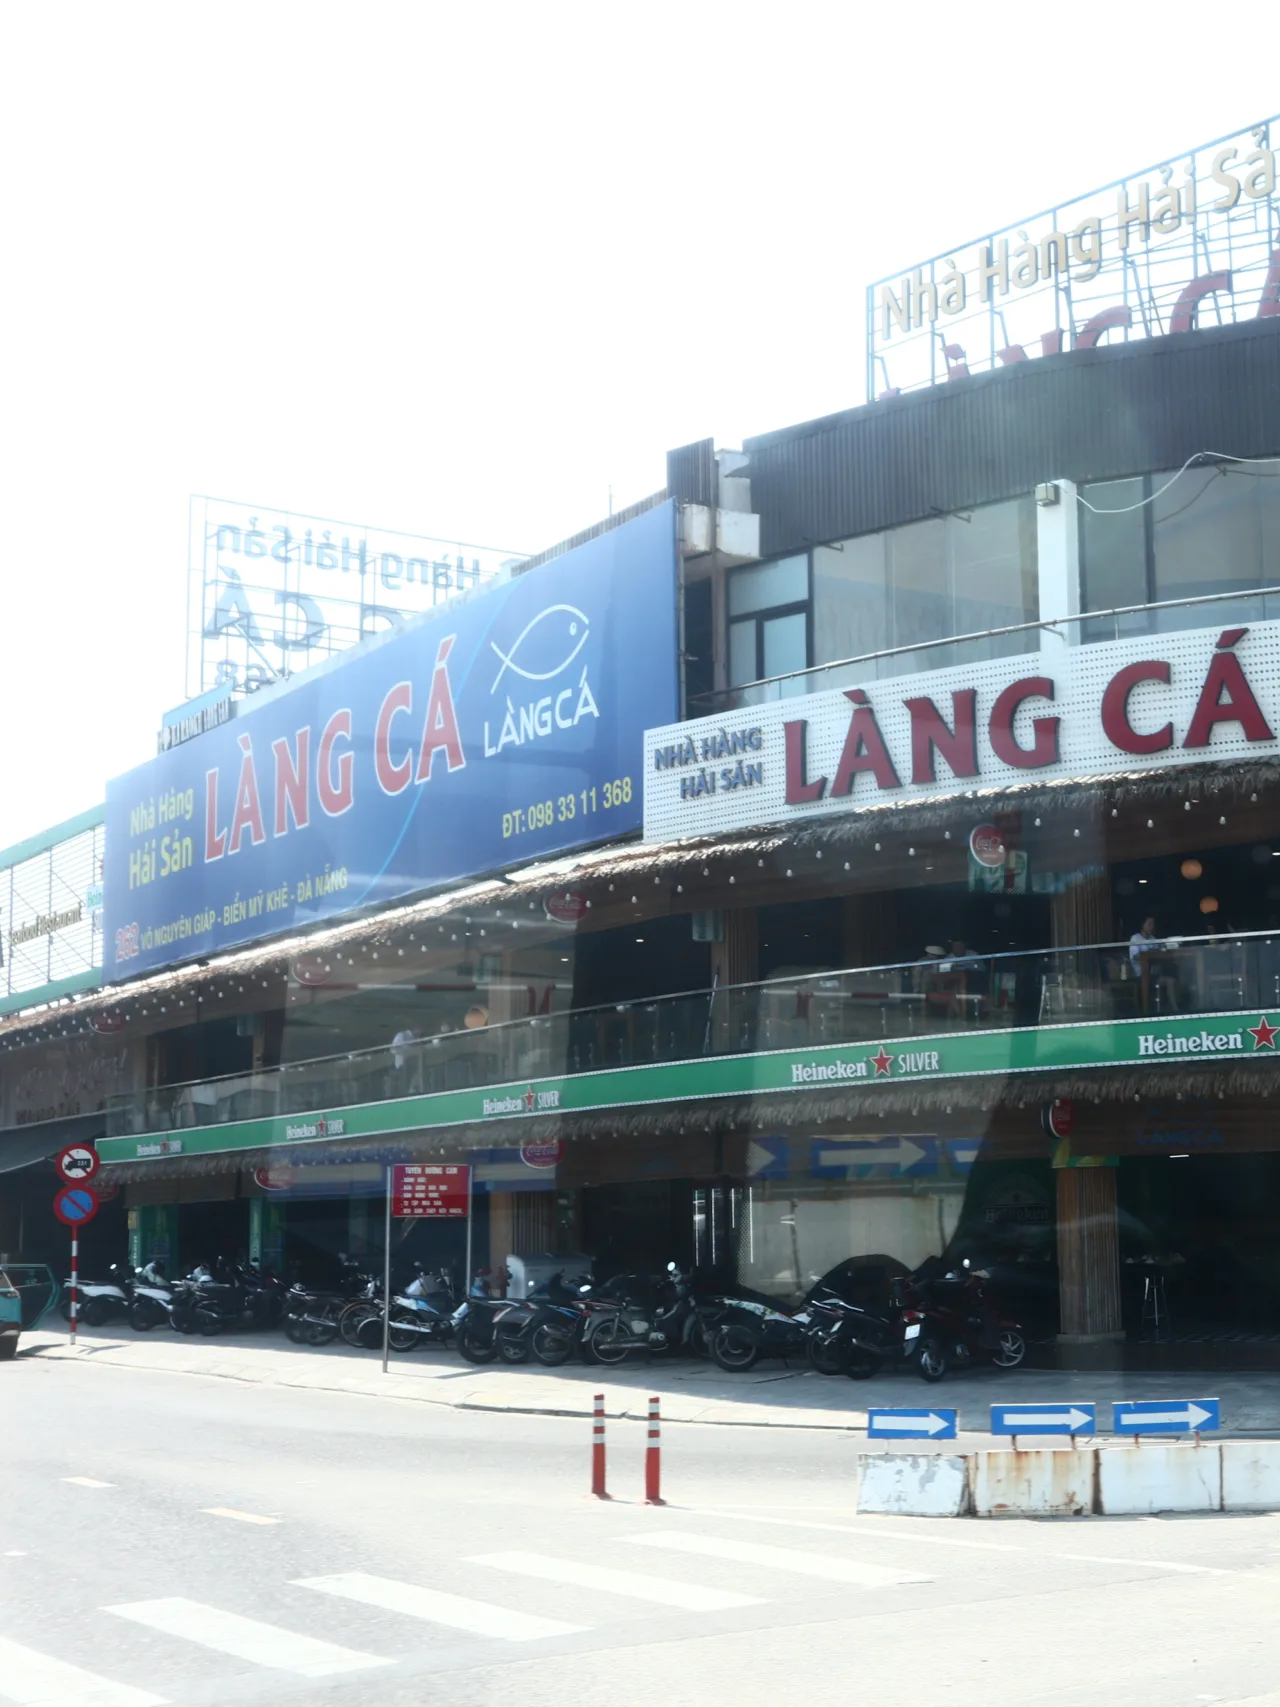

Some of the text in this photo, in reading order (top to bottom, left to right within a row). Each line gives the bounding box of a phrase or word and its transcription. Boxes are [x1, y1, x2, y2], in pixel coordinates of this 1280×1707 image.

[880, 258, 966, 341] Nhà
[978, 216, 1102, 303] Hàng
[1116, 163, 1196, 250] Hải
[783, 627, 1276, 806] LÀNG CÁ
[204, 633, 467, 864] LÀNG CÁ
[654, 726, 762, 770] NHÀ HÀNG
[558, 793, 575, 822] 33
[580, 787, 596, 815] 11
[602, 776, 632, 809] 368
[680, 759, 762, 800] HẢI SẢN
[130, 786, 194, 838] Nhà Hàng
[129, 828, 192, 890] Hải Sản
[115, 921, 139, 963] 262
[1138, 1028, 1243, 1056] Heineken
[791, 1051, 939, 1082] Heineken SILVER
[483, 1096, 522, 1115] Heineken
[286, 1125, 316, 1139] Heineken
